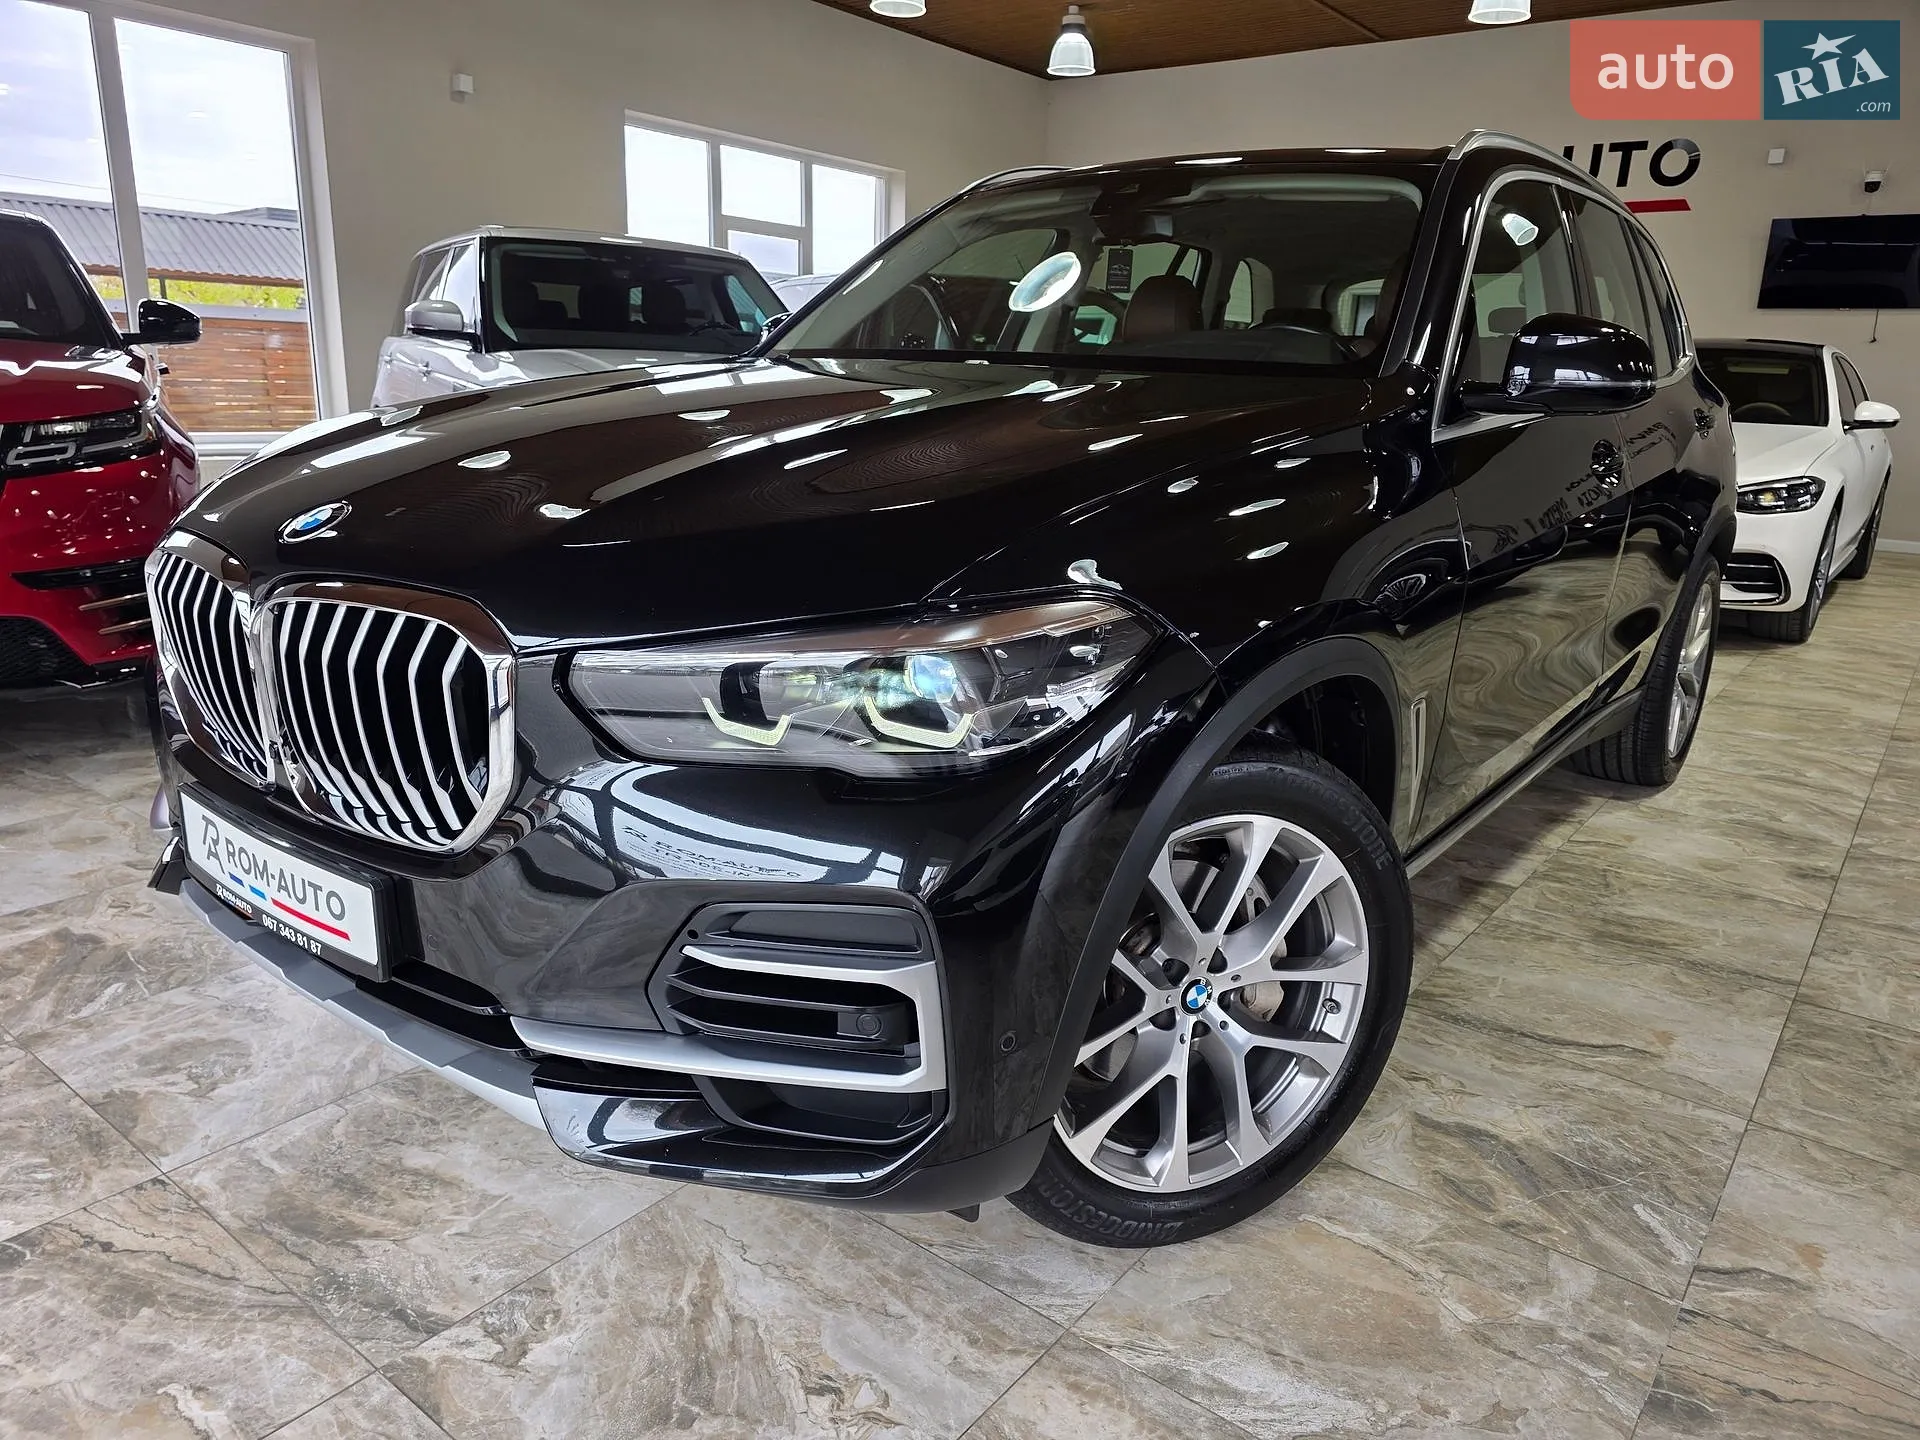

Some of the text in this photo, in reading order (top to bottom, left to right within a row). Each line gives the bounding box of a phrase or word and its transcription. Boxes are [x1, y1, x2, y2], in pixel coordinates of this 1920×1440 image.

[224, 837, 346, 921] ROM-AUTO
[262, 914, 322, 955] 067 343 81 87
